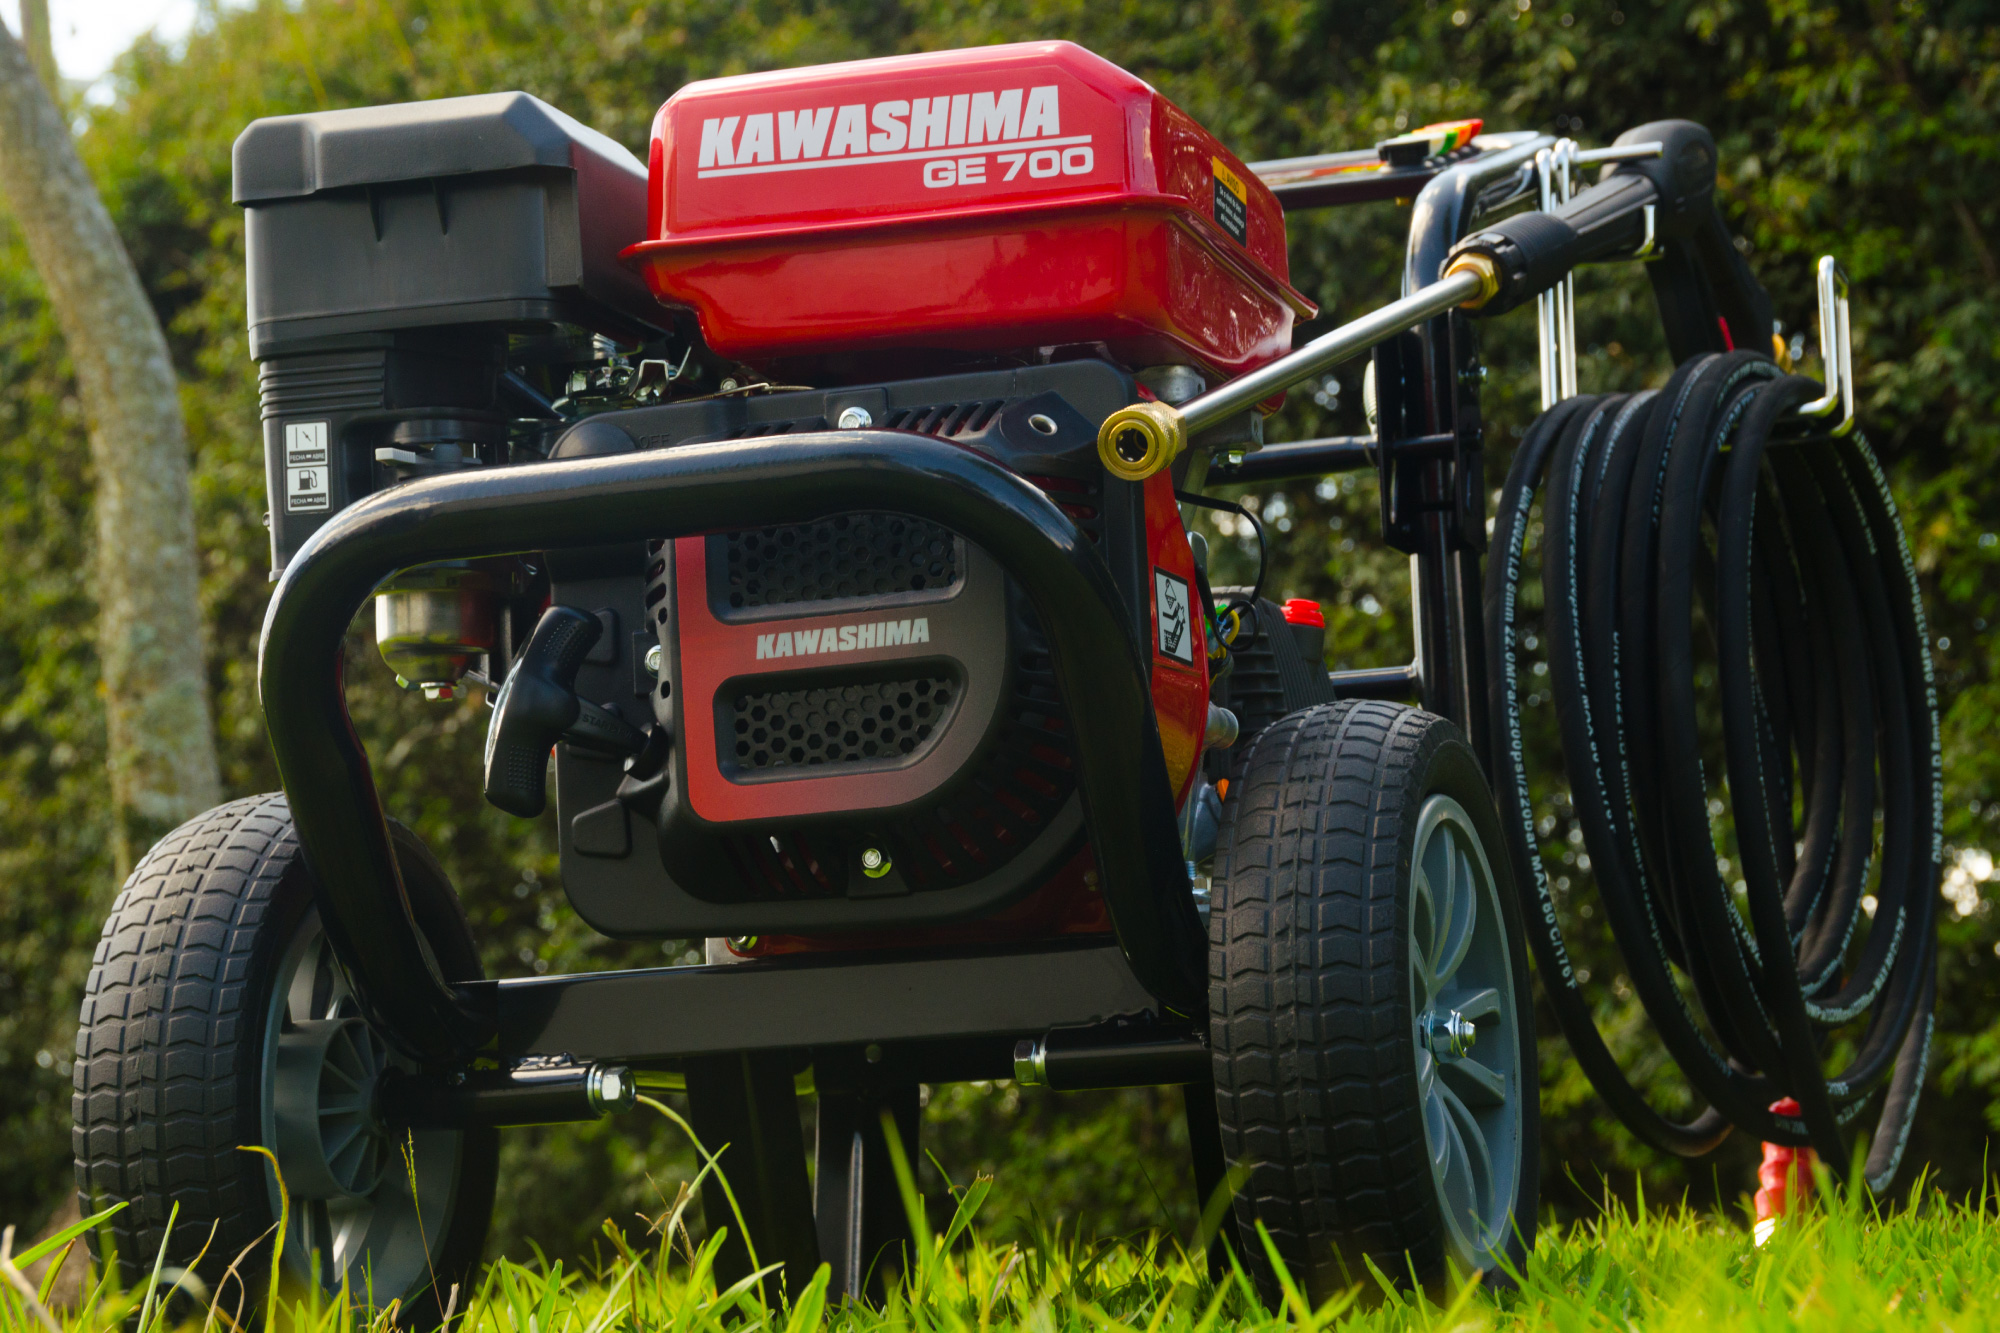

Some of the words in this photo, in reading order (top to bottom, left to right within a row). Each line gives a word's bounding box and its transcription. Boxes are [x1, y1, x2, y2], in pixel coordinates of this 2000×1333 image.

[697, 85, 1061, 168] KAWASHIMA
[923, 157, 987, 188] GE
[997, 146, 1094, 182] 700
[638, 432, 670, 449] OFF
[1518, 485, 1533, 513] DIN
[1509, 511, 1527, 557] 20022
[756, 617, 930, 660] KAWASHIMA
[1531, 855, 1550, 899] MAX
